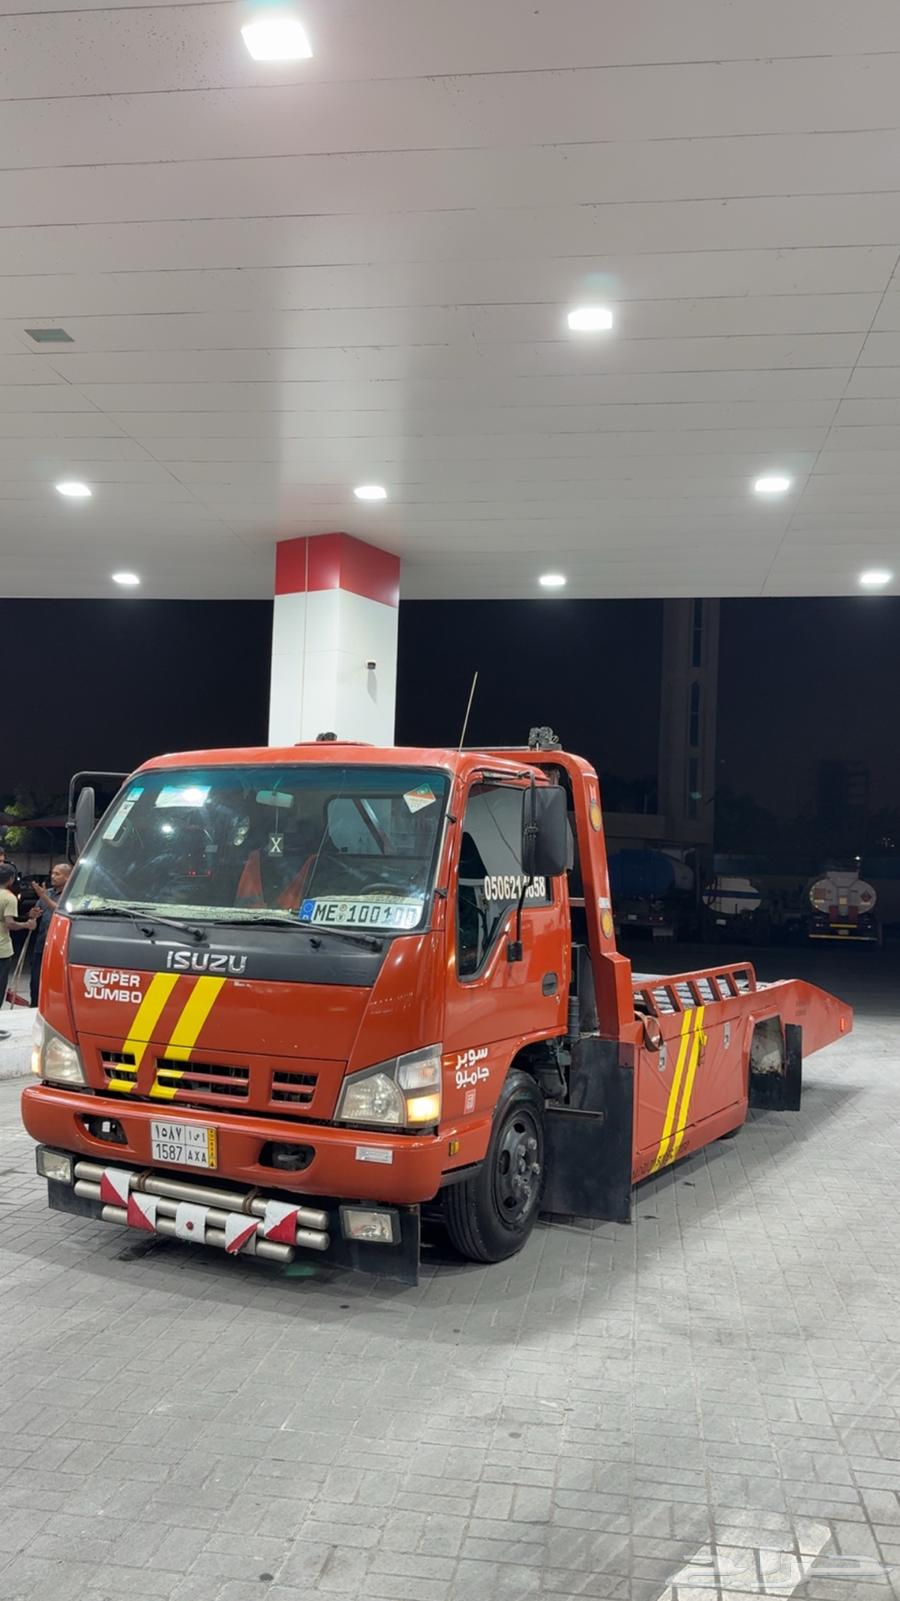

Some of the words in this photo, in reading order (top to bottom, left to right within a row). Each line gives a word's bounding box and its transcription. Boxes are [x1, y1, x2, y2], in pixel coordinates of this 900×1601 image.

[313, 904, 338, 922] ME
[166, 950, 248, 974] ISUZU
[88, 971, 141, 988] SUPER
[84, 986, 143, 1004] JUMBO
[455, 1047, 489, 1070] سوبر
[455, 1066, 490, 1090] جامبو
[155, 1143, 183, 1161] 1587
